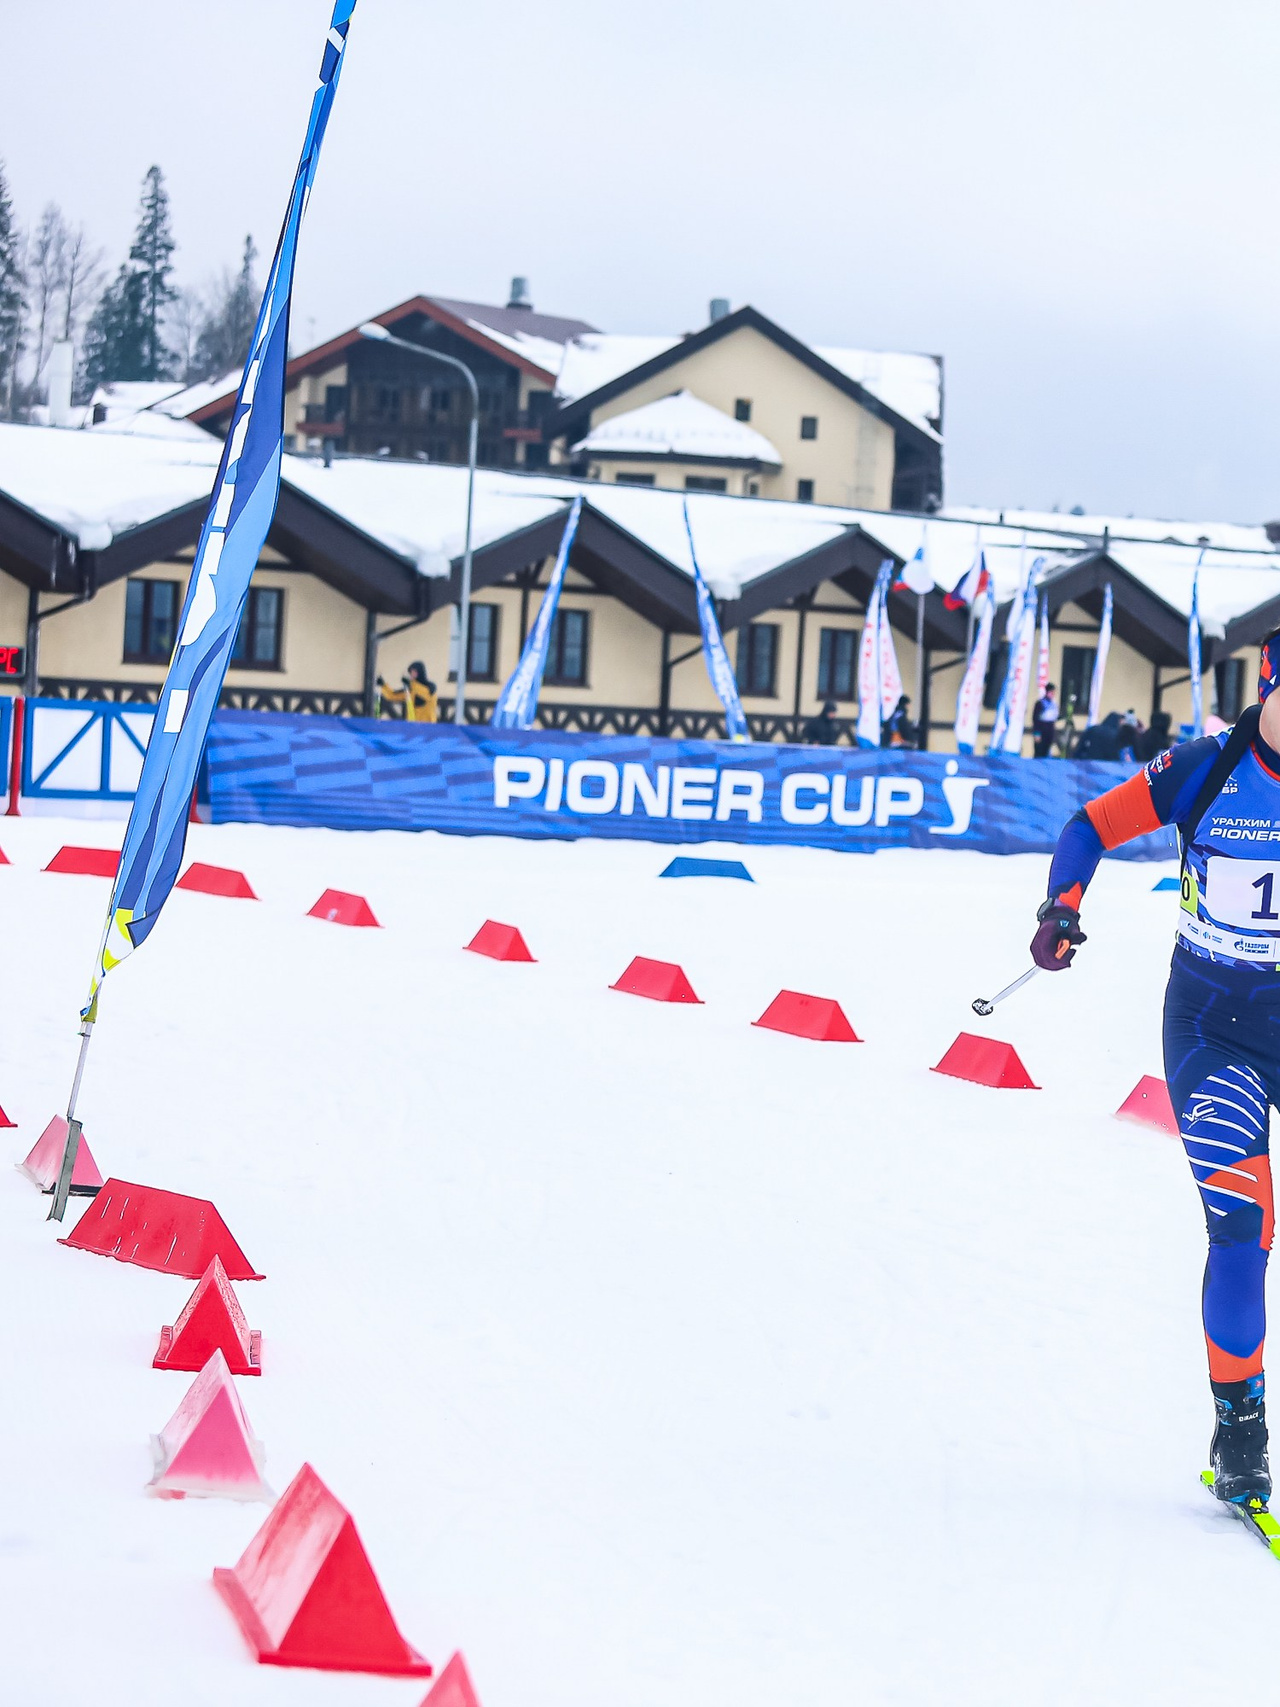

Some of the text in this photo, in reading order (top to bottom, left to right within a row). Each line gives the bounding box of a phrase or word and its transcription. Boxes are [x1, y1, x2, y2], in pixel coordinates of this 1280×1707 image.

[493, 755, 925, 828] PIONER CUP
[1211, 817, 1271, 828] УРАЛХИМ
